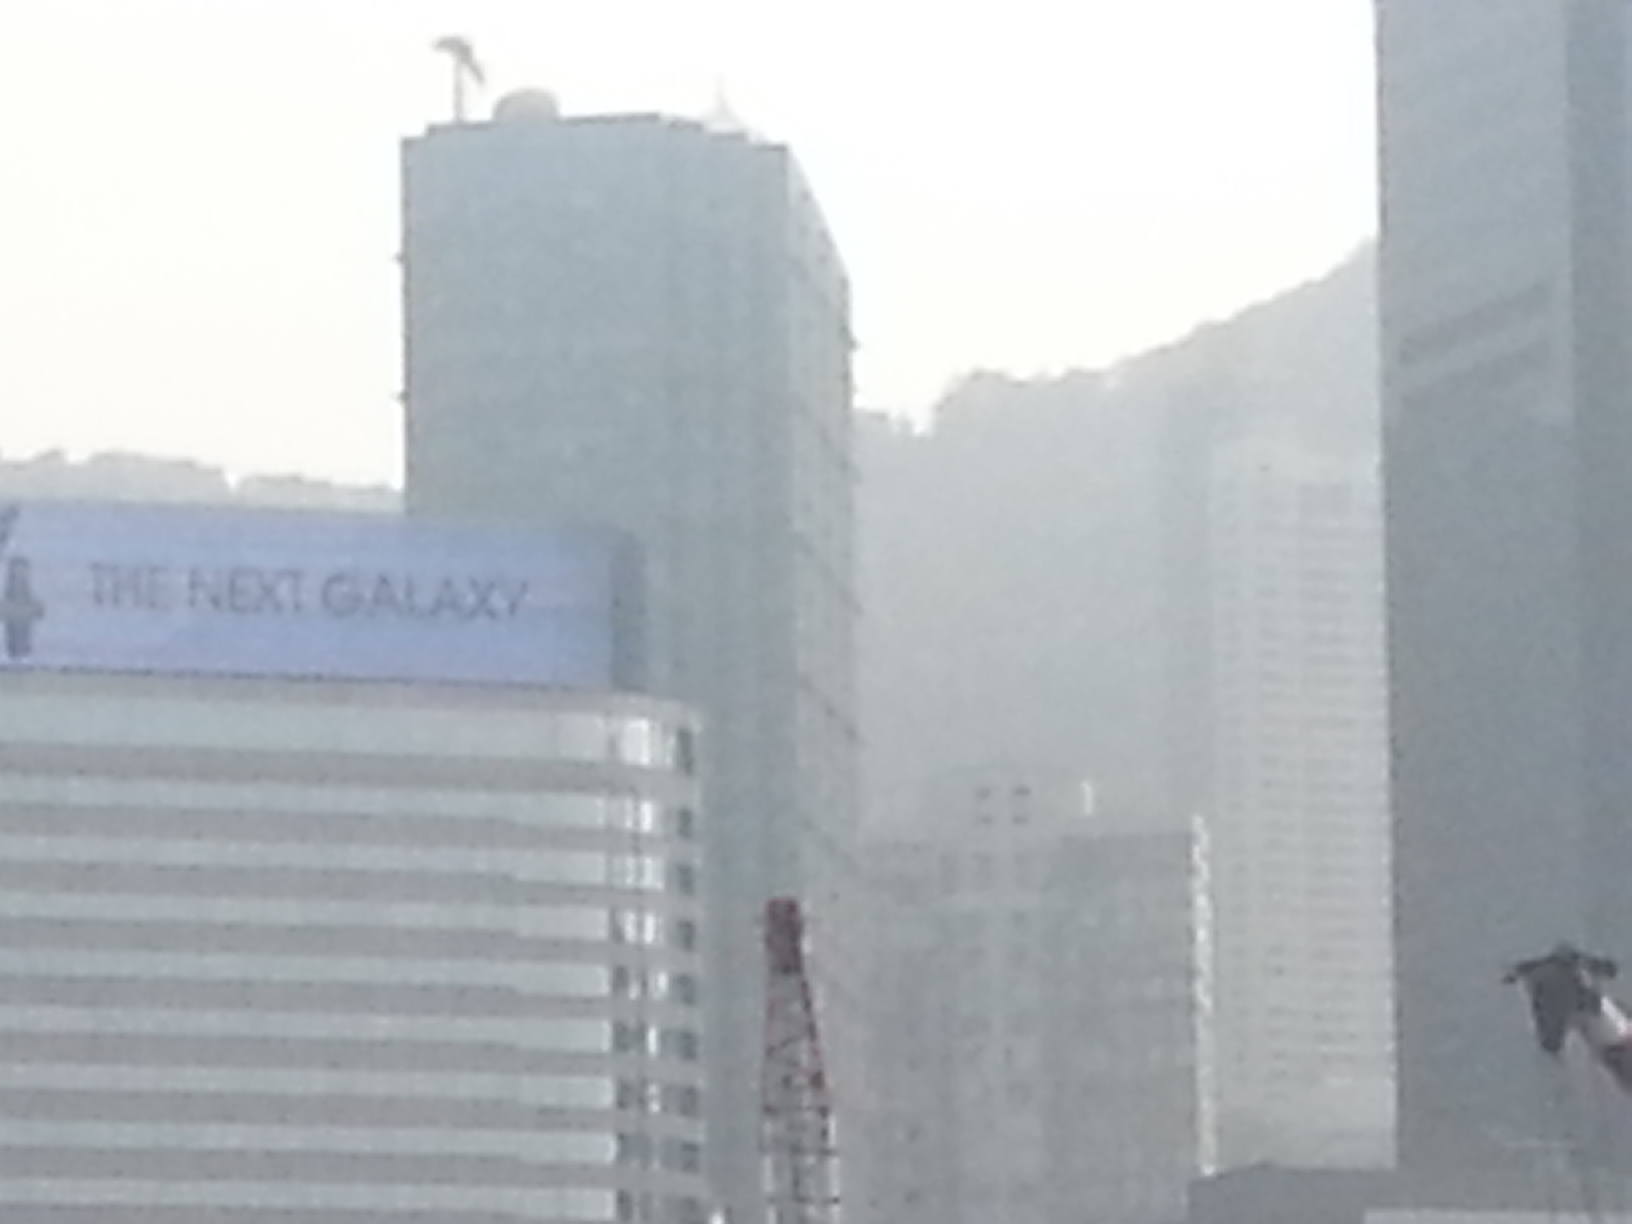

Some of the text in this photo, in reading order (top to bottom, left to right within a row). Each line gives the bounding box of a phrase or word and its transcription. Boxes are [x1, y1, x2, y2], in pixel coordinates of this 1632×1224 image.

[87, 561, 167, 611] THE
[187, 565, 304, 615] NEXT
[321, 570, 530, 622] GALAXY
